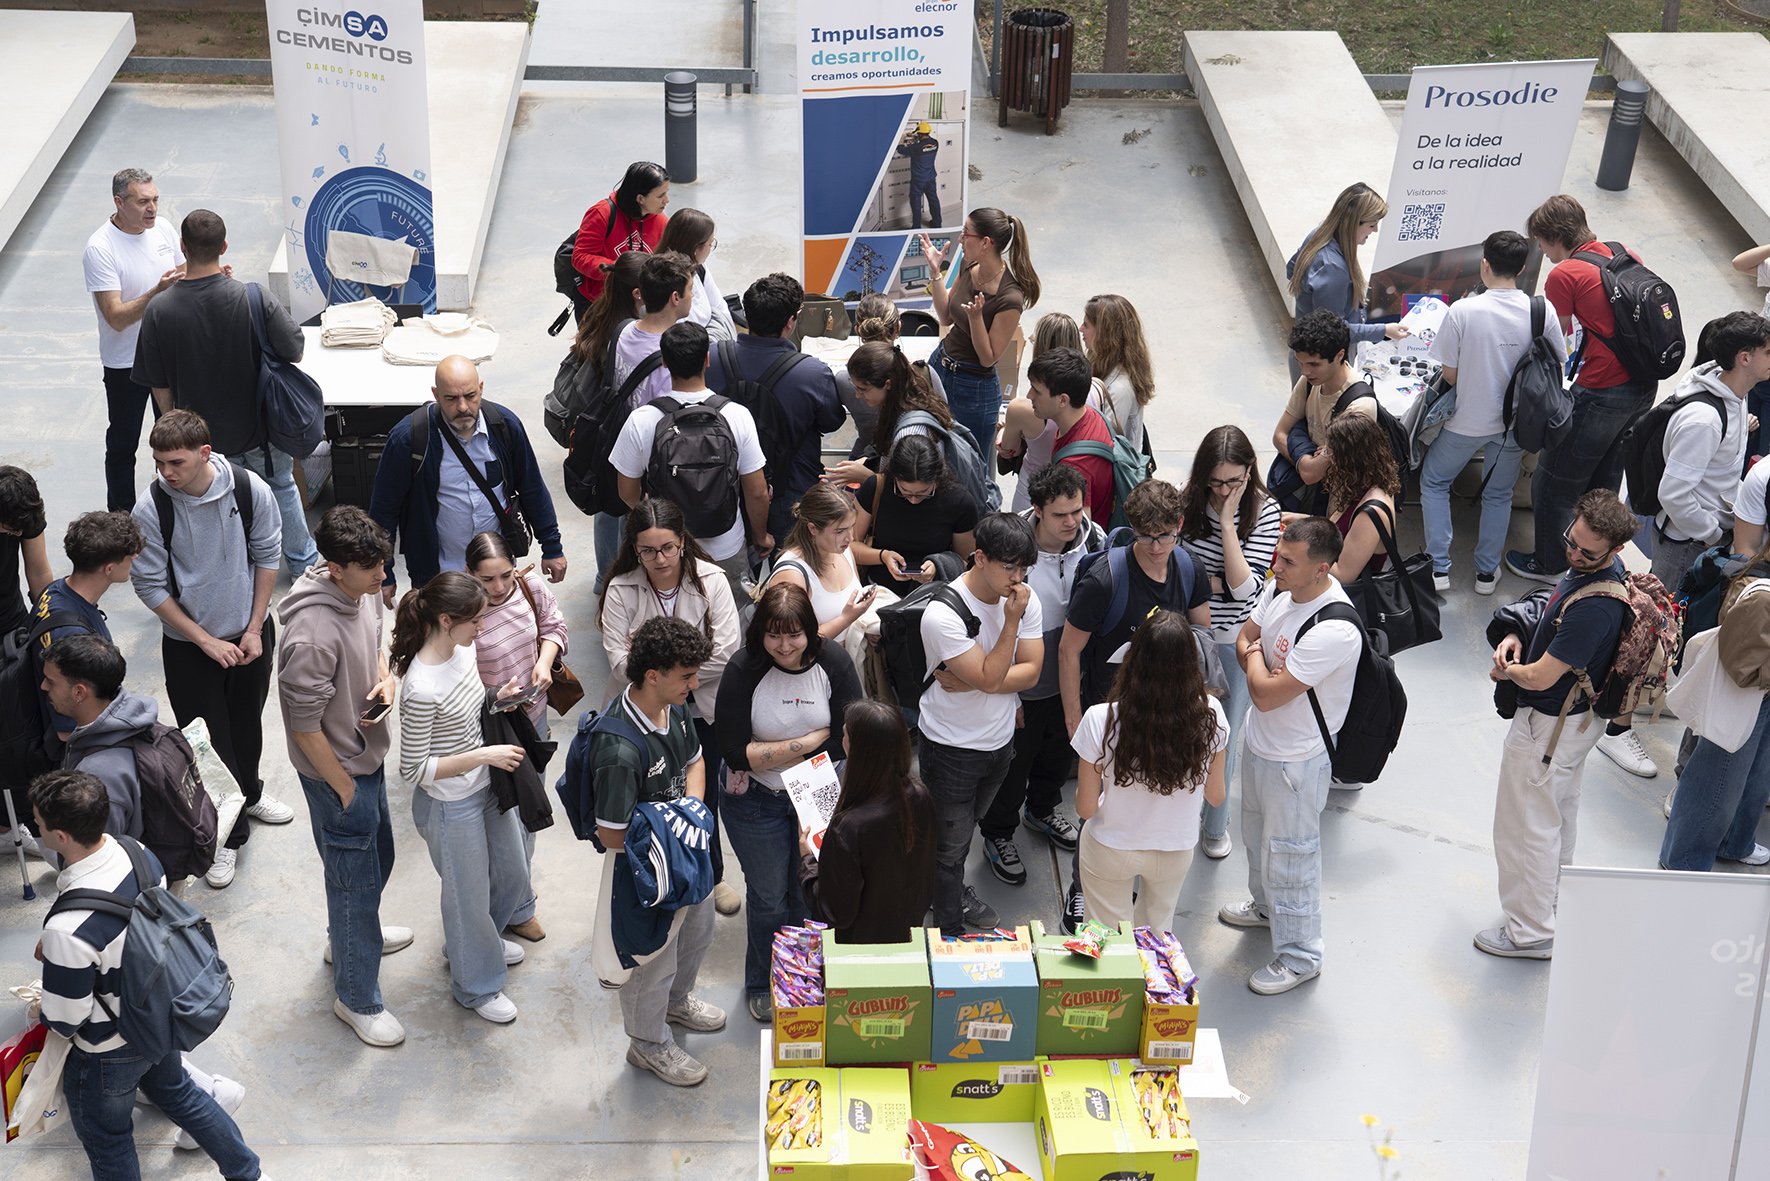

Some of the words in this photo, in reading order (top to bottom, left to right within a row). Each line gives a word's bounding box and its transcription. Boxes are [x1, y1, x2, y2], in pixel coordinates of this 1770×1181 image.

[915, 2, 957, 12] elecnor
[811, 25, 944, 45] Impulsamos
[277, 30, 413, 65] CEMENTOS
[811, 46, 925, 65] desarrollo,
[306, 62, 343, 74] DANDO
[350, 69, 385, 82] FORMA
[811, 71, 858, 81] creamos
[861, 67, 942, 80] oportunidades
[317, 76, 330, 85] AL
[336, 79, 378, 93] FUTURO
[1424, 82, 1558, 108] Prosodie
[1417, 135, 1441, 149] De
[1445, 134, 1461, 148] la
[1465, 133, 1503, 147] idea
[1412, 159, 1424, 170] a
[1428, 156, 1444, 169] la
[1449, 153, 1522, 169] realidad
[390, 210, 429, 254] FUTURE
